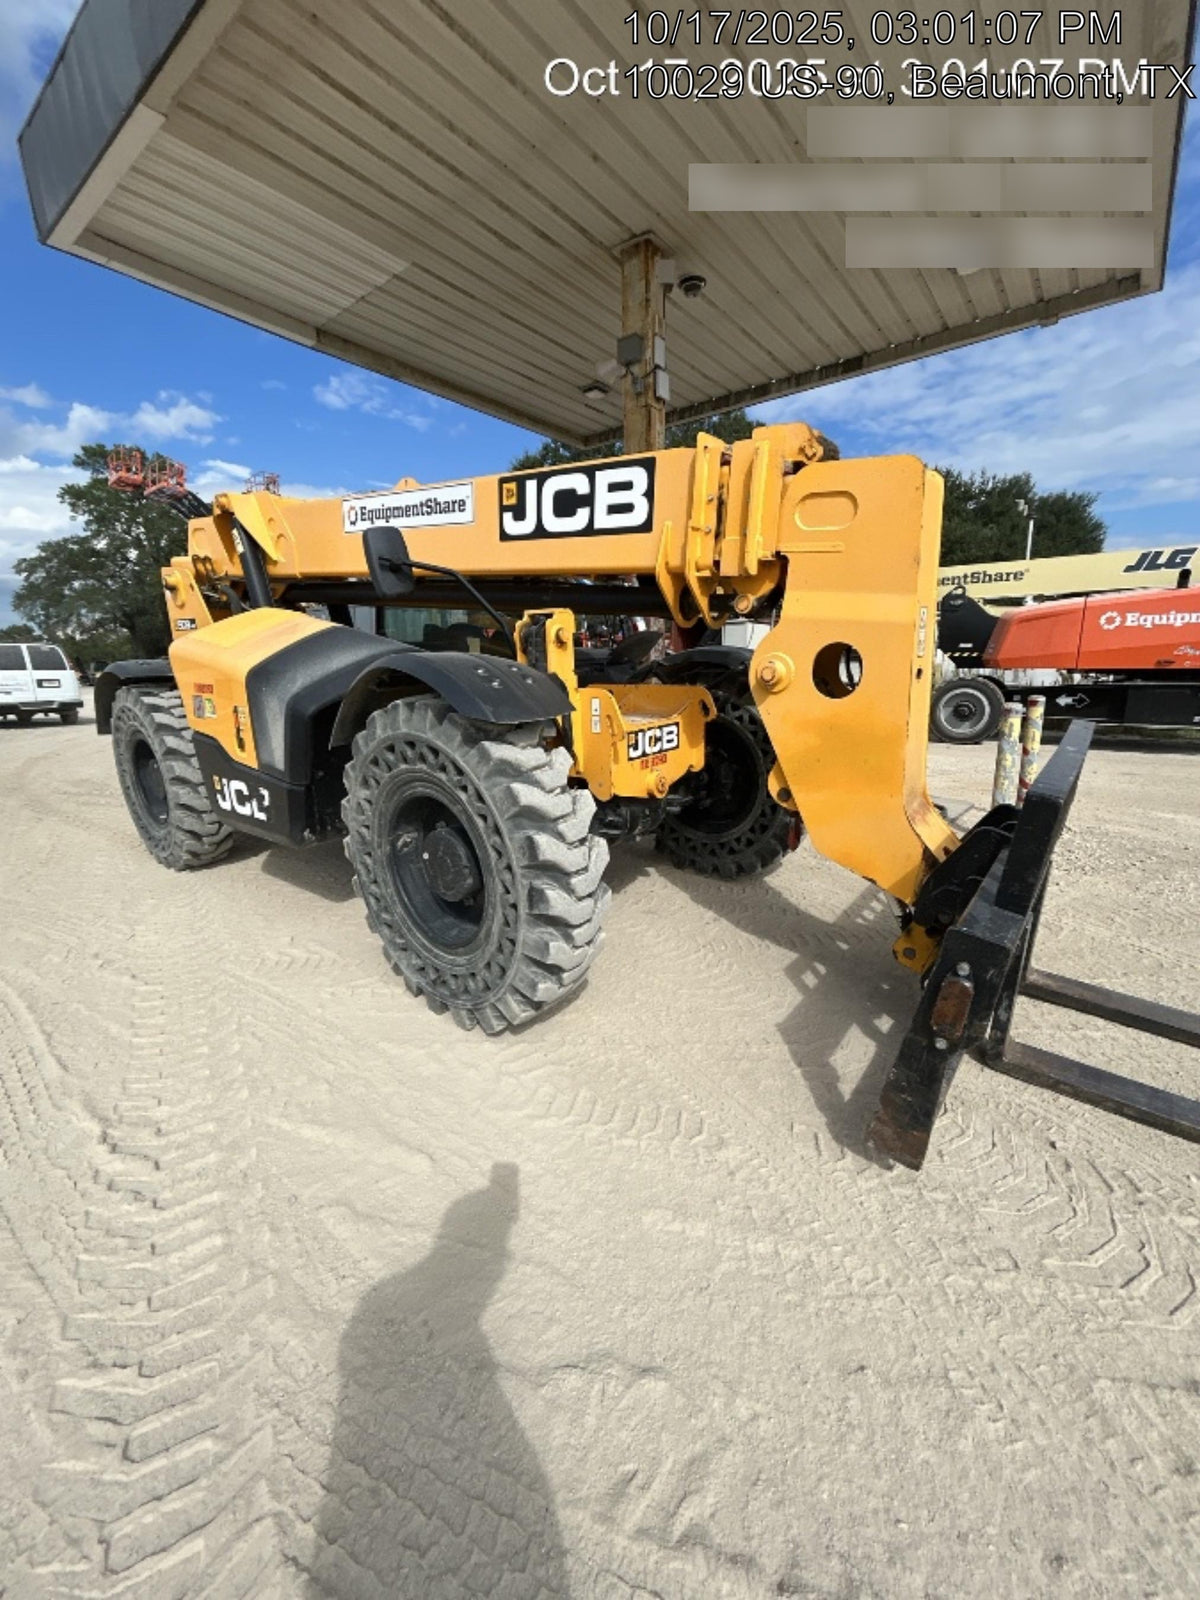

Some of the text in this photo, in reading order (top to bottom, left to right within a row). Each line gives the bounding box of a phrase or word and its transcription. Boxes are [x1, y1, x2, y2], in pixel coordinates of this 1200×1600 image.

[359, 497, 466, 525] EquipmentShare
[502, 465, 650, 536] JCB
[1122, 547, 1199, 572] JLG
[629, 724, 678, 759] JCB
